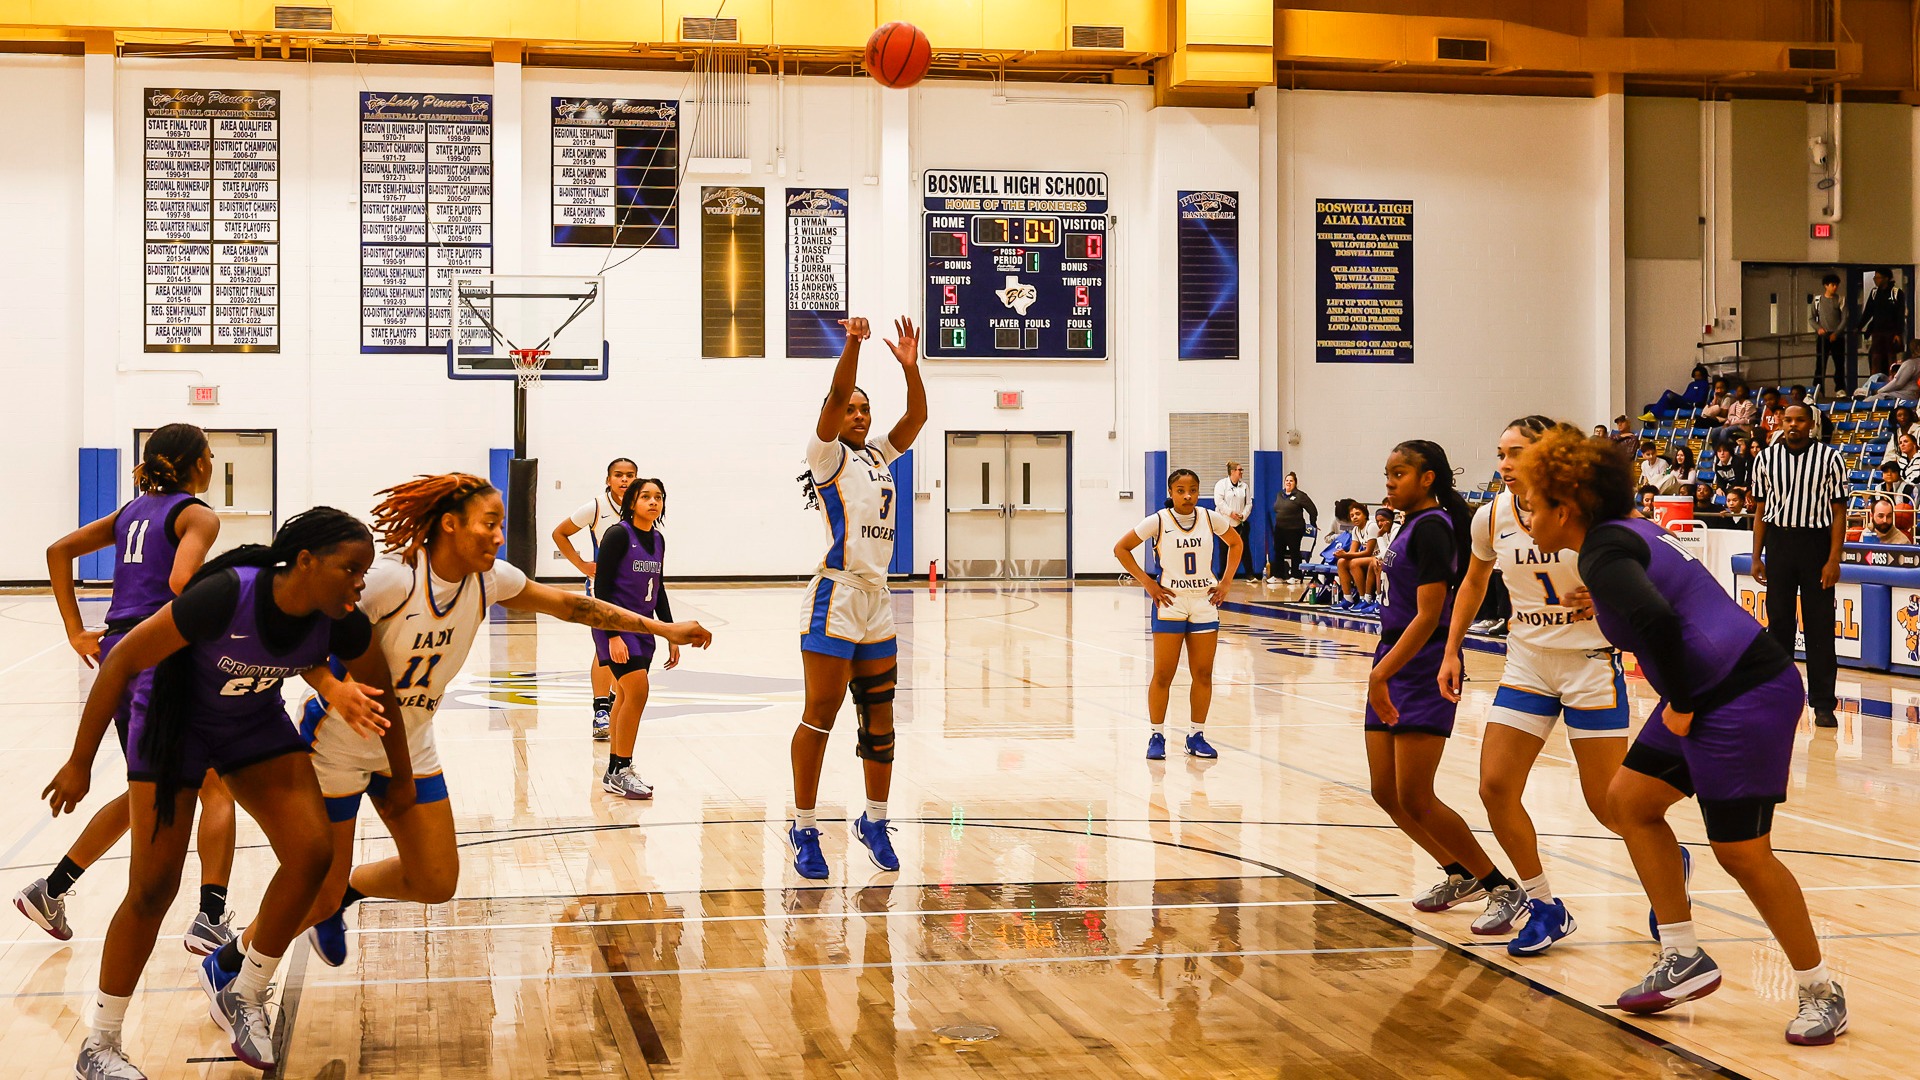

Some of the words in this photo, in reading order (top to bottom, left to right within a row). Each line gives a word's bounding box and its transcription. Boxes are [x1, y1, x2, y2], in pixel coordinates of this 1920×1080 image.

[174, 90, 205, 105] Lady
[209, 91, 253, 104] Pioneer
[386, 95, 419, 109] Lady
[423, 95, 468, 108] Pioneer
[148, 109, 203, 117] VOLLEYBALL
[418, 114, 488, 122] CHAMPIONSHIPS
[148, 120, 167, 129] STATE
[170, 121, 188, 130] FINAL
[190, 121, 207, 130] FOUR
[220, 121, 237, 130] AREA
[239, 121, 272, 131] QUALIFIER
[364, 124, 385, 133] REGION
[387, 124, 391, 133] II
[392, 124, 424, 134] RUNNER-UP
[429, 125, 454, 135] DISTRICT
[456, 126, 489, 136] CHAMPIONS
[555, 129, 578, 138] REGIONAL
[579, 129, 613, 139] SEMI-FINALIST
[147, 141, 175, 150] REGIONAL
[177, 141, 209, 151] RUNNER-UP
[562, 149, 575, 158] AREA
[577, 149, 607, 159] CHAMPIONS
[147, 161, 175, 170] REGIONAL
[177, 161, 209, 171] RUNNER-UP
[562, 169, 575, 178] AREA
[577, 169, 607, 178] CHAMPIONS
[146, 181, 175, 190] REGIONAL
[177, 181, 209, 191] RUNNER-UP
[928, 175, 998, 195] BOSWELL
[1004, 176, 1039, 196] HIGH
[1046, 177, 1105, 196] SCHOOL
[559, 188, 587, 197] BI-DISTRICT
[588, 188, 609, 198] FINALIST
[1180, 192, 1237, 208] PIONEER
[945, 199, 980, 210] HOME
[983, 200, 999, 210] OF
[1002, 201, 1025, 210] THE
[1028, 201, 1087, 212] PIONEERS
[1317, 203, 1377, 213] BOSWELL
[1379, 203, 1412, 214] HIGH
[563, 208, 576, 217] AREA
[577, 208, 605, 217] CHAMPIONS
[705, 207, 761, 216] VOLLEYBALL
[790, 208, 844, 217] BASKETBALL
[1182, 211, 1235, 219] BASKETBALL
[794, 218, 799, 226] 0
[801, 218, 827, 226] HYMAN
[932, 217, 965, 228] HOME
[1063, 219, 1105, 230] VISITOR
[1323, 216, 1360, 225] ALMA
[1362, 216, 1406, 226] MATER
[795, 227, 799, 236] 1
[801, 227, 837, 236] WILLIAMS
[994, 219, 1054, 242] 7:04
[1816, 225, 1829, 236] EXIT
[794, 236, 799, 244] 2
[801, 236, 832, 245] DANIELS
[952, 233, 966, 256] 7
[795, 246, 799, 254] 3
[801, 246, 831, 254] MASSEY
[1087, 235, 1102, 258] 0
[794, 255, 799, 263] 4
[801, 255, 824, 263] JONES
[994, 256, 1023, 264] PERIOD
[794, 264, 799, 273] 5
[801, 264, 831, 273] DURRAH
[945, 261, 971, 269] BONUS
[1061, 263, 1087, 271] BONUS
[801, 274, 834, 282] JACKSON
[931, 276, 971, 285] TIMEOUTS
[1062, 278, 1102, 286] TIMEOUTS
[790, 283, 799, 291] 15
[801, 283, 837, 291] ANDREWS
[790, 292, 799, 300] 24
[801, 292, 839, 301] CARRASCO
[945, 286, 956, 303] 5
[1077, 287, 1088, 305] 5
[790, 302, 799, 310] 31
[801, 302, 839, 310] O'CONNOR
[941, 306, 959, 314] LEFT
[1073, 307, 1092, 315] LEFT
[940, 319, 965, 327] FOULS
[990, 319, 1019, 327] PLAYER
[1025, 319, 1050, 327] FOULS
[1067, 320, 1092, 328] FOULS
[156, 327, 170, 336] AREA
[172, 327, 201, 336] CHAMPION
[219, 327, 231, 336] REG.
[233, 327, 272, 337] SEMI-FINALIST
[371, 328, 388, 338] STATE
[390, 328, 416, 338] PLAYOFFS
[953, 329, 964, 347] 0
[880, 488, 893, 519] 3
[123, 519, 150, 564] 11
[1176, 538, 1202, 548] LADY
[1515, 549, 1561, 564] LADY
[1872, 552, 1887, 564] POSS
[1184, 551, 1197, 575] 0
[645, 578, 653, 601] 1
[1535, 572, 1560, 606] 1
[412, 627, 455, 650] LADY
[396, 653, 442, 689] 11
